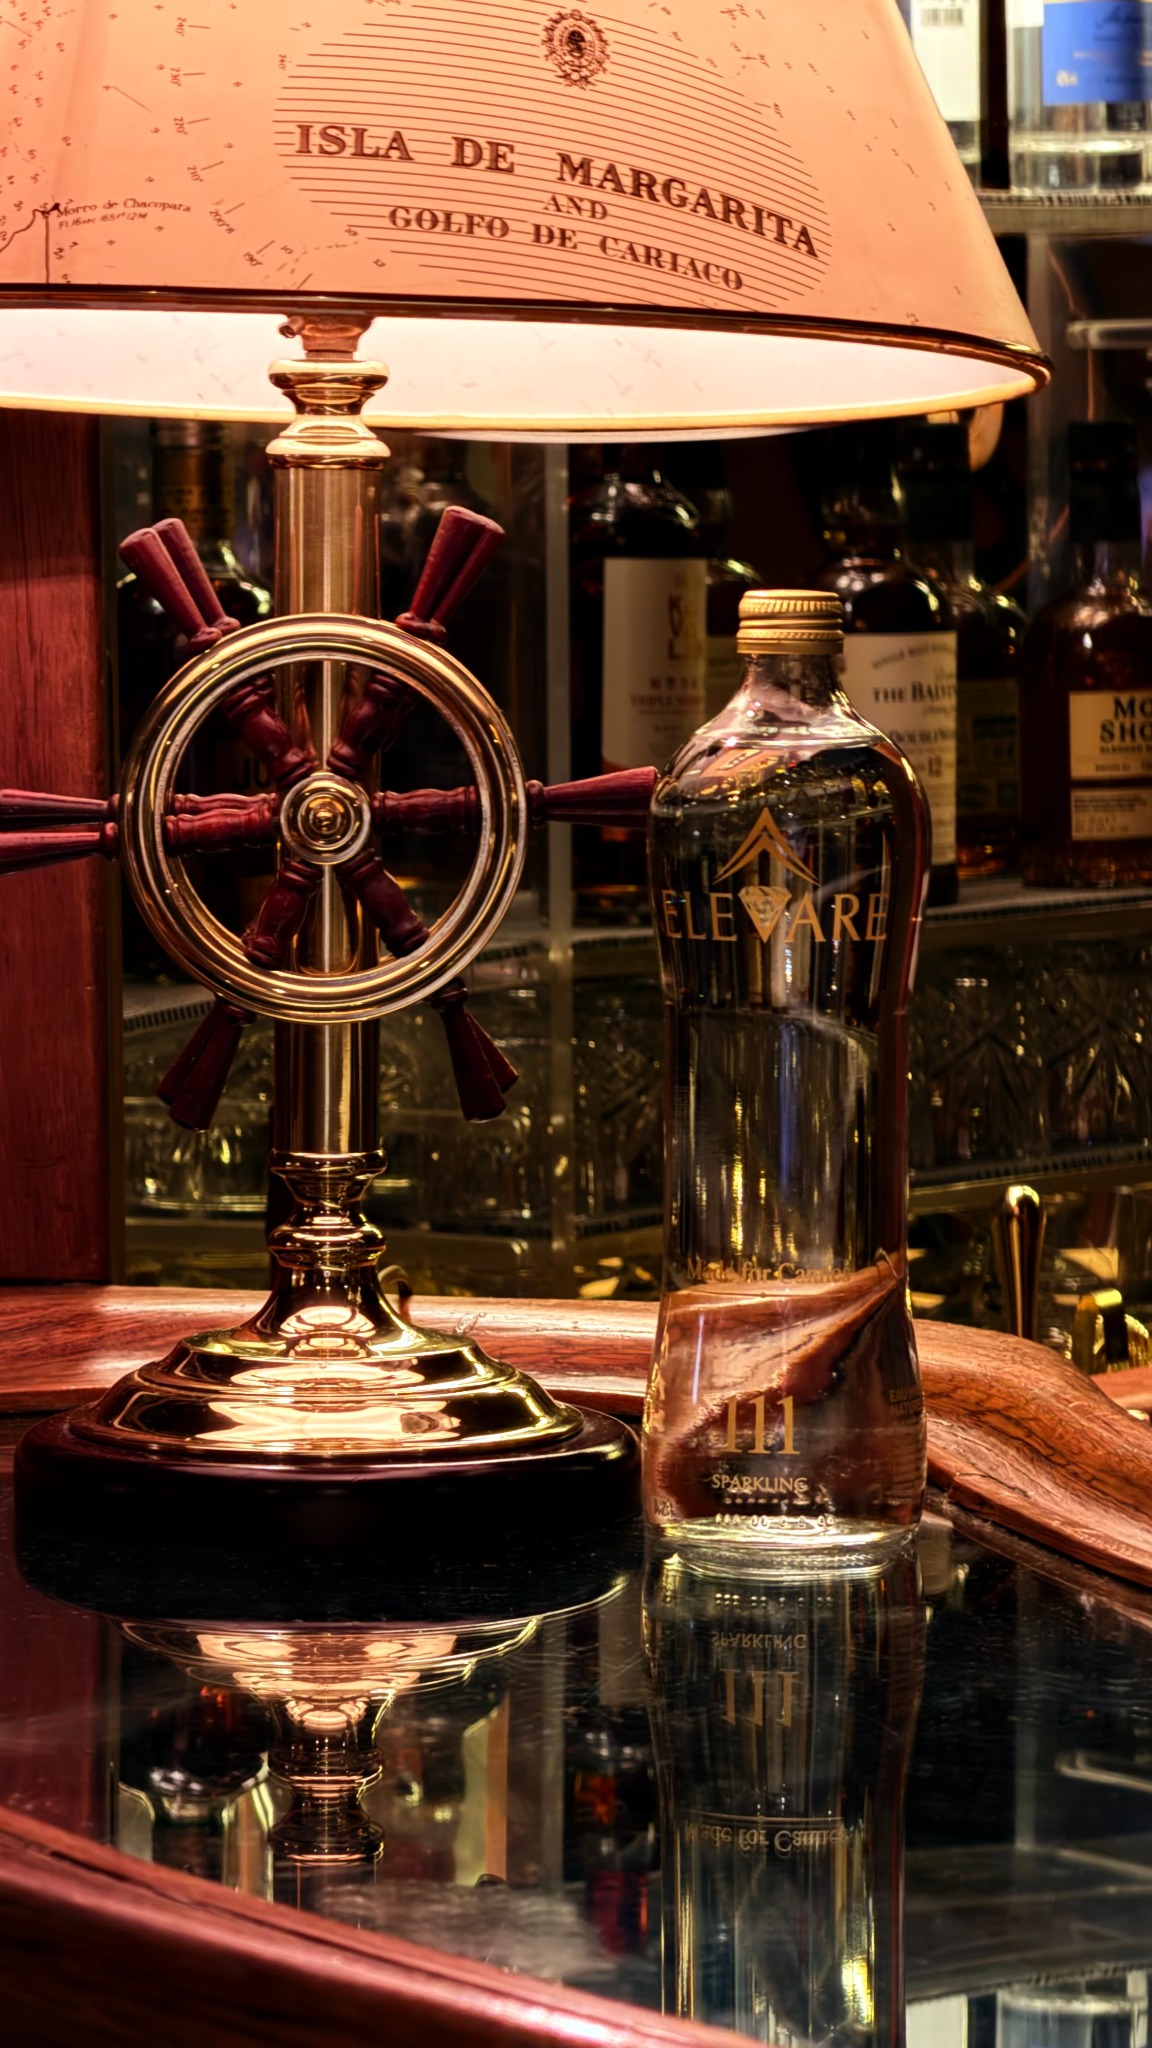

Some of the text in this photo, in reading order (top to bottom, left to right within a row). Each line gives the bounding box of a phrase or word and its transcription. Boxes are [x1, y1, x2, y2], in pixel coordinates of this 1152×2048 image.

[296, 124, 819, 259] ISLA DE MARGARITA
[542, 194, 608, 220] AND
[388, 206, 743, 291] GOLFO DE CARIACO
[873, 687, 906, 703] THE
[661, 885, 889, 943] ELEVARE
[742, 1260, 772, 1283] for
[722, 1394, 801, 1455] 111
[711, 1473, 809, 1493] SPARKLING
